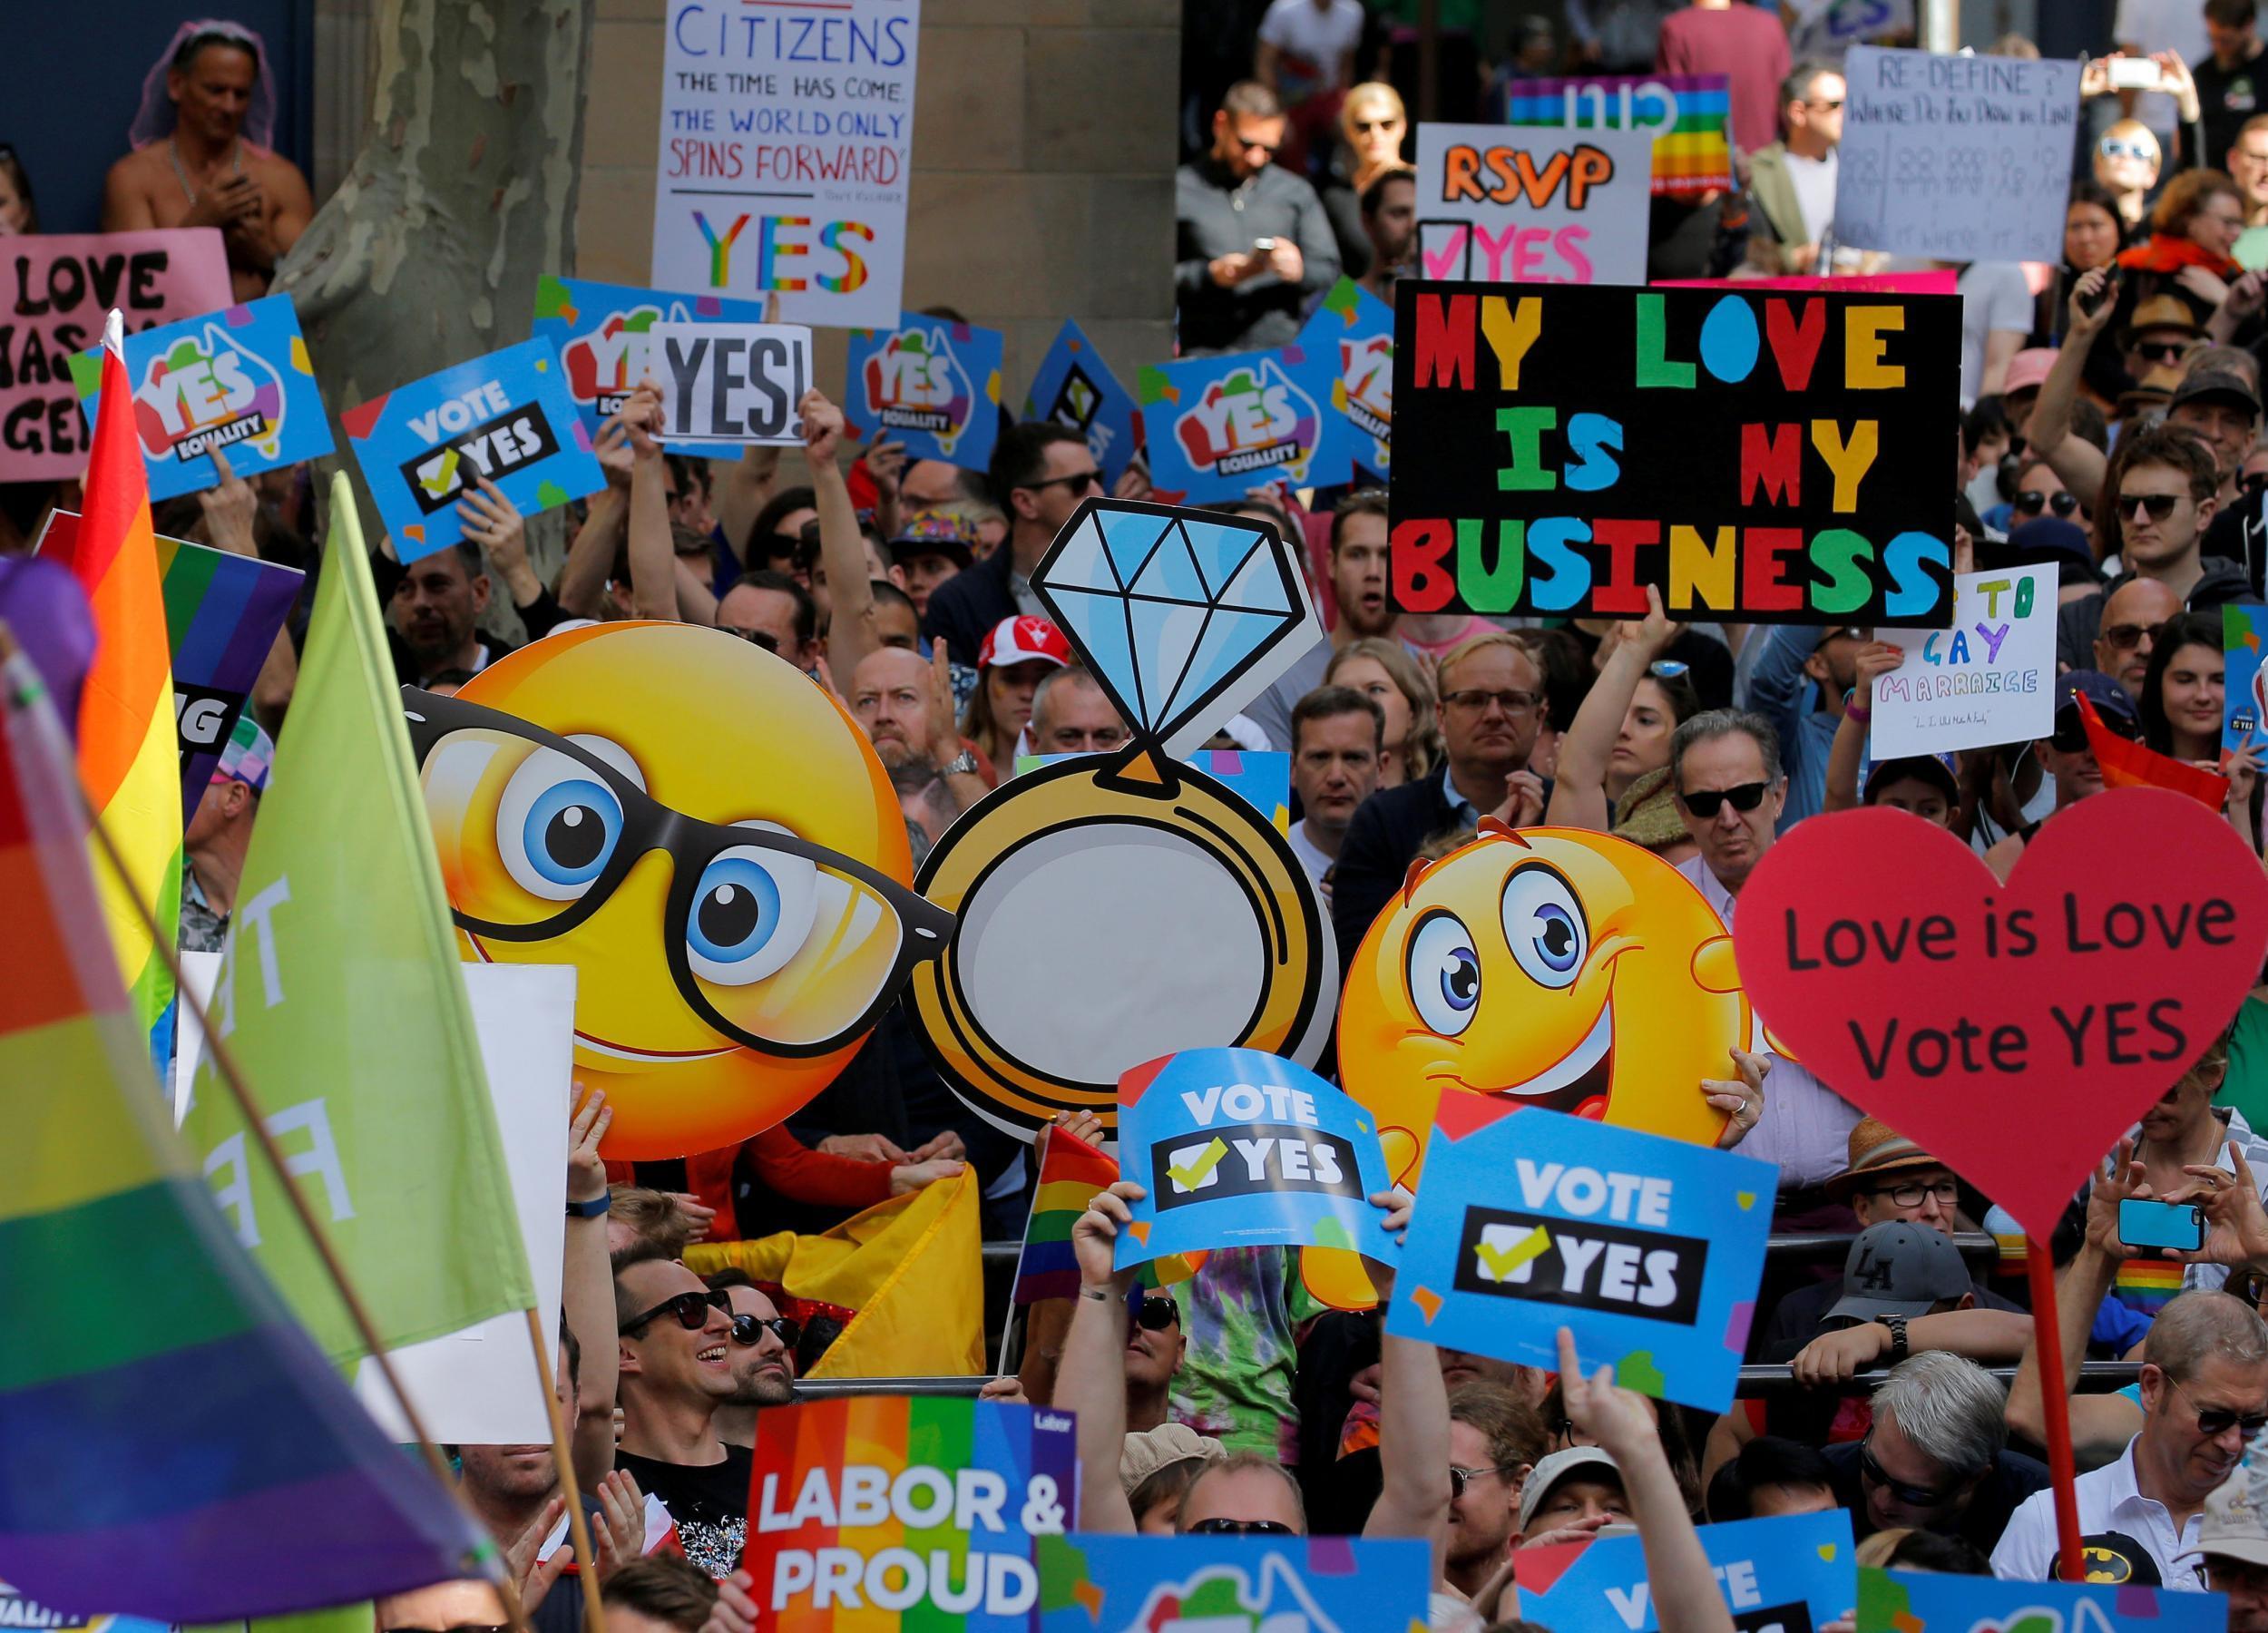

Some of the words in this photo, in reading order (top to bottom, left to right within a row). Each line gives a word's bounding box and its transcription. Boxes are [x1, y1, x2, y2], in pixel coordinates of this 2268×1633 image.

[676, 5, 909, 66] CITIZENS
[677, 72, 718, 93] THE
[727, 73, 777, 94] TIME
[795, 77, 835, 99] HAS
[671, 110, 715, 132] THE
[729, 108, 830, 135] WORLD
[837, 112, 904, 138] ONLY
[668, 139, 743, 179] SPINS
[1442, 143, 1614, 210] RSVP
[15, 251, 168, 316] LOVE
[692, 210, 875, 294] YES
[1472, 223, 1594, 284] YES
[1414, 293, 1542, 391] MY
[1637, 293, 1905, 391] LOVE
[138, 350, 256, 435] YES
[665, 337, 805, 437] YES!
[876, 351, 953, 406] YES
[178, 414, 261, 459] EQUALITY
[406, 379, 511, 445] VOTE
[882, 408, 949, 431] EQUALITY
[1193, 385, 1297, 453] YES
[458, 416, 543, 475] YES
[1219, 443, 1296, 474] EQUALITY
[1496, 406, 1624, 492] IS
[1741, 419, 1879, 513] MY
[1391, 516, 1950, 617] BUSINESS
[1977, 576, 2035, 620] TO
[1923, 622, 2009, 666] GAY
[1785, 907, 1957, 971] Love
[1984, 897, 2038, 958] is
[2064, 892, 2236, 953] Love
[1847, 1016, 2028, 1081] Vote
[2049, 999, 2187, 1066] YES
[1180, 1083, 1318, 1126] VOTE
[1231, 1137, 1344, 1185] YES
[1515, 1159, 1672, 1227] VOTE
[1556, 1234, 1679, 1307] YES
[1034, 1413, 1071, 1433] Labor
[758, 1465, 1007, 1533] LABOR
[1021, 1473, 1065, 1535] &
[771, 1547, 1039, 1616] PROUD
